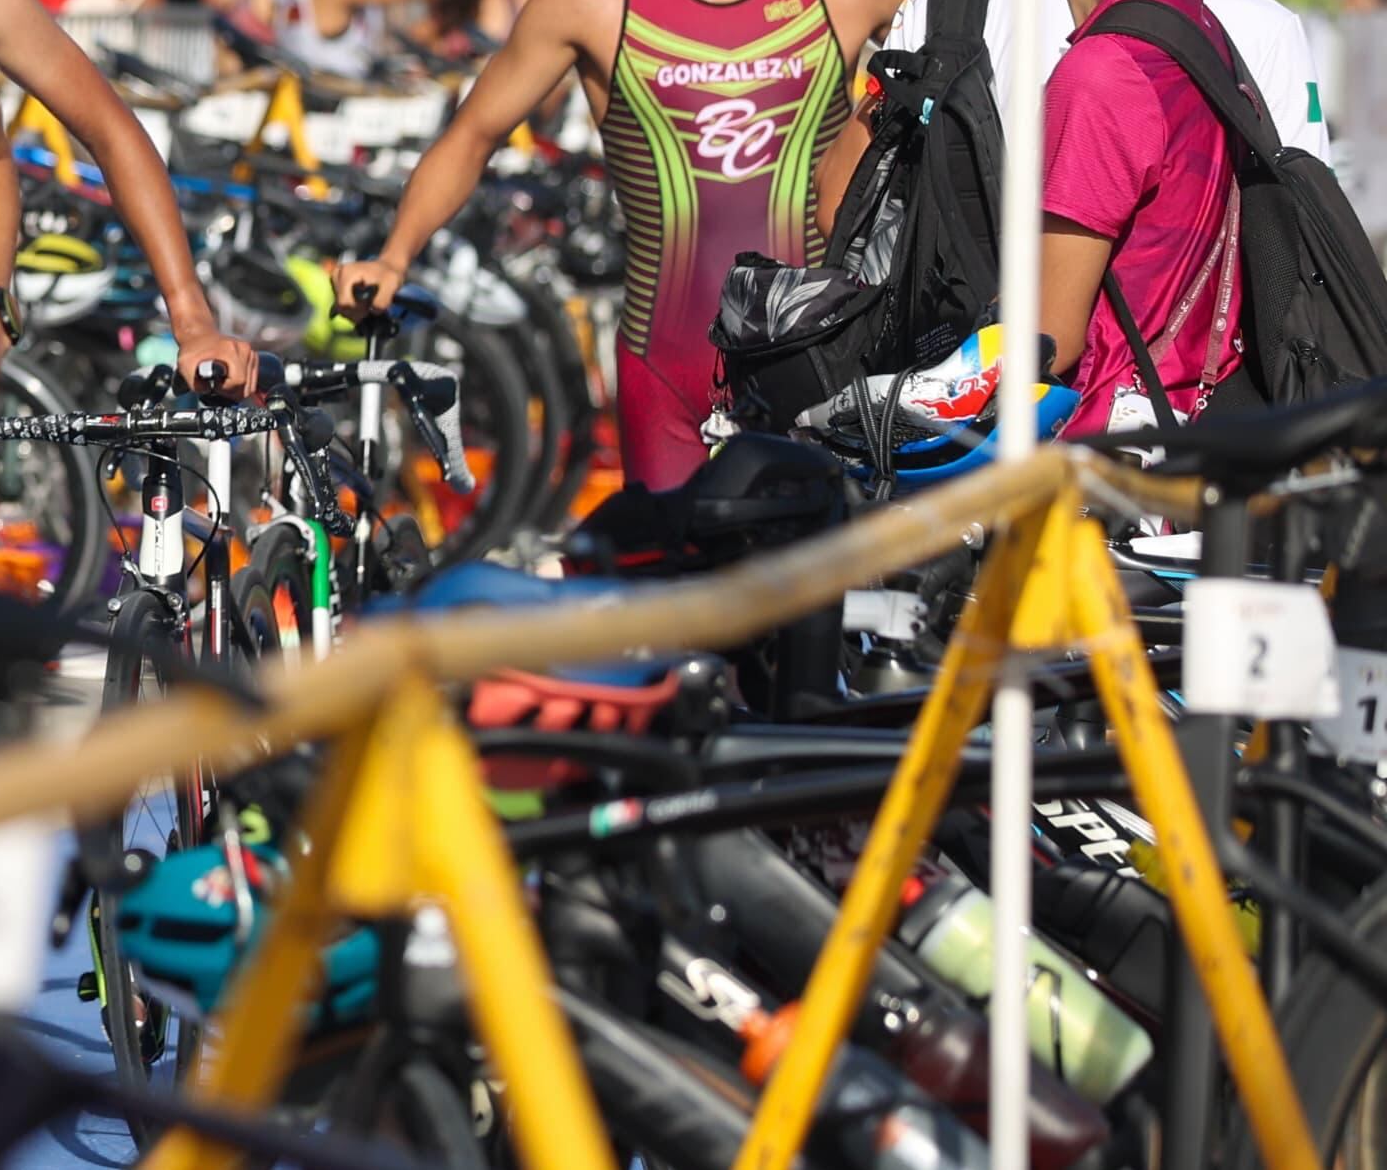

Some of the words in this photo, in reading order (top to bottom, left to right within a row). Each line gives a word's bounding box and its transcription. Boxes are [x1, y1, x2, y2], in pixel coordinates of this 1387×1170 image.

[657, 58, 784, 87] GONZALEZ
[695, 98, 776, 178] BC
[1249, 635, 1269, 678] 2
